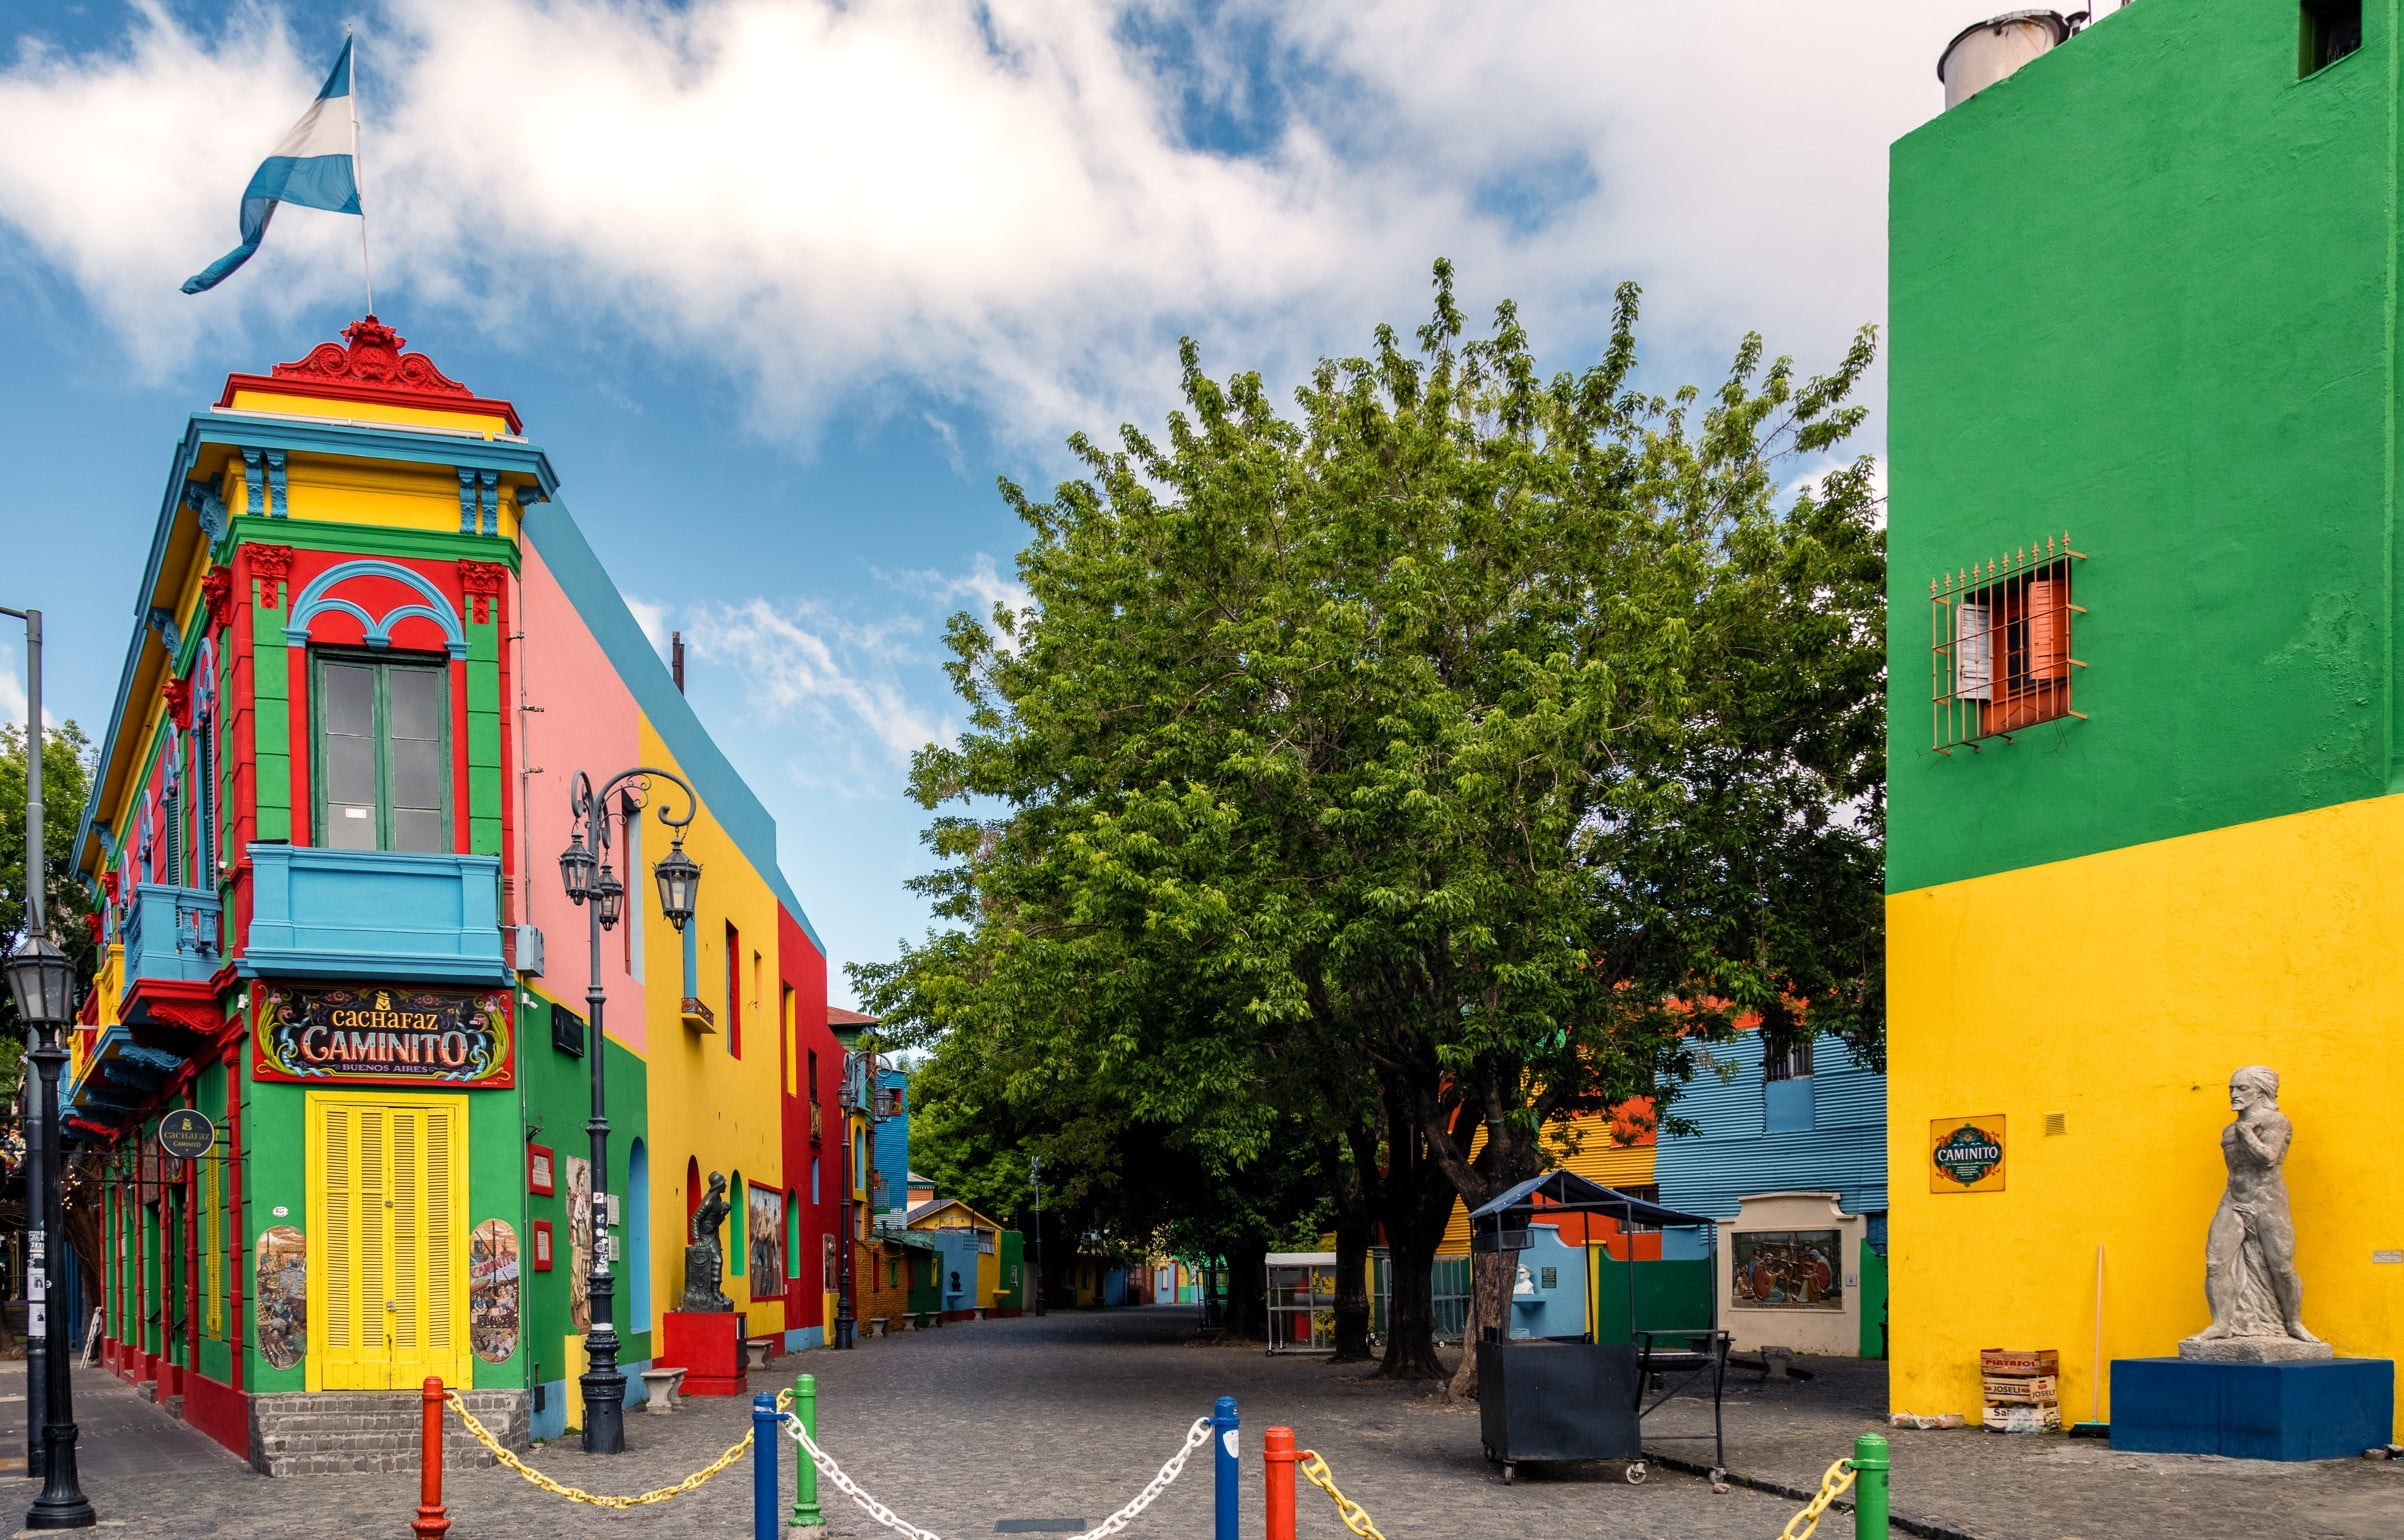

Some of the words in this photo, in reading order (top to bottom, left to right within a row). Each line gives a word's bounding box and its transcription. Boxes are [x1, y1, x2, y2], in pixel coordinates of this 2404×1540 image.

[301, 1025, 468, 1066] CAMINITO
[342, 1063, 389, 1073] BUENOS
[393, 1064, 428, 1074] AIRES
[1937, 1147, 1998, 1162] CAMINITO
